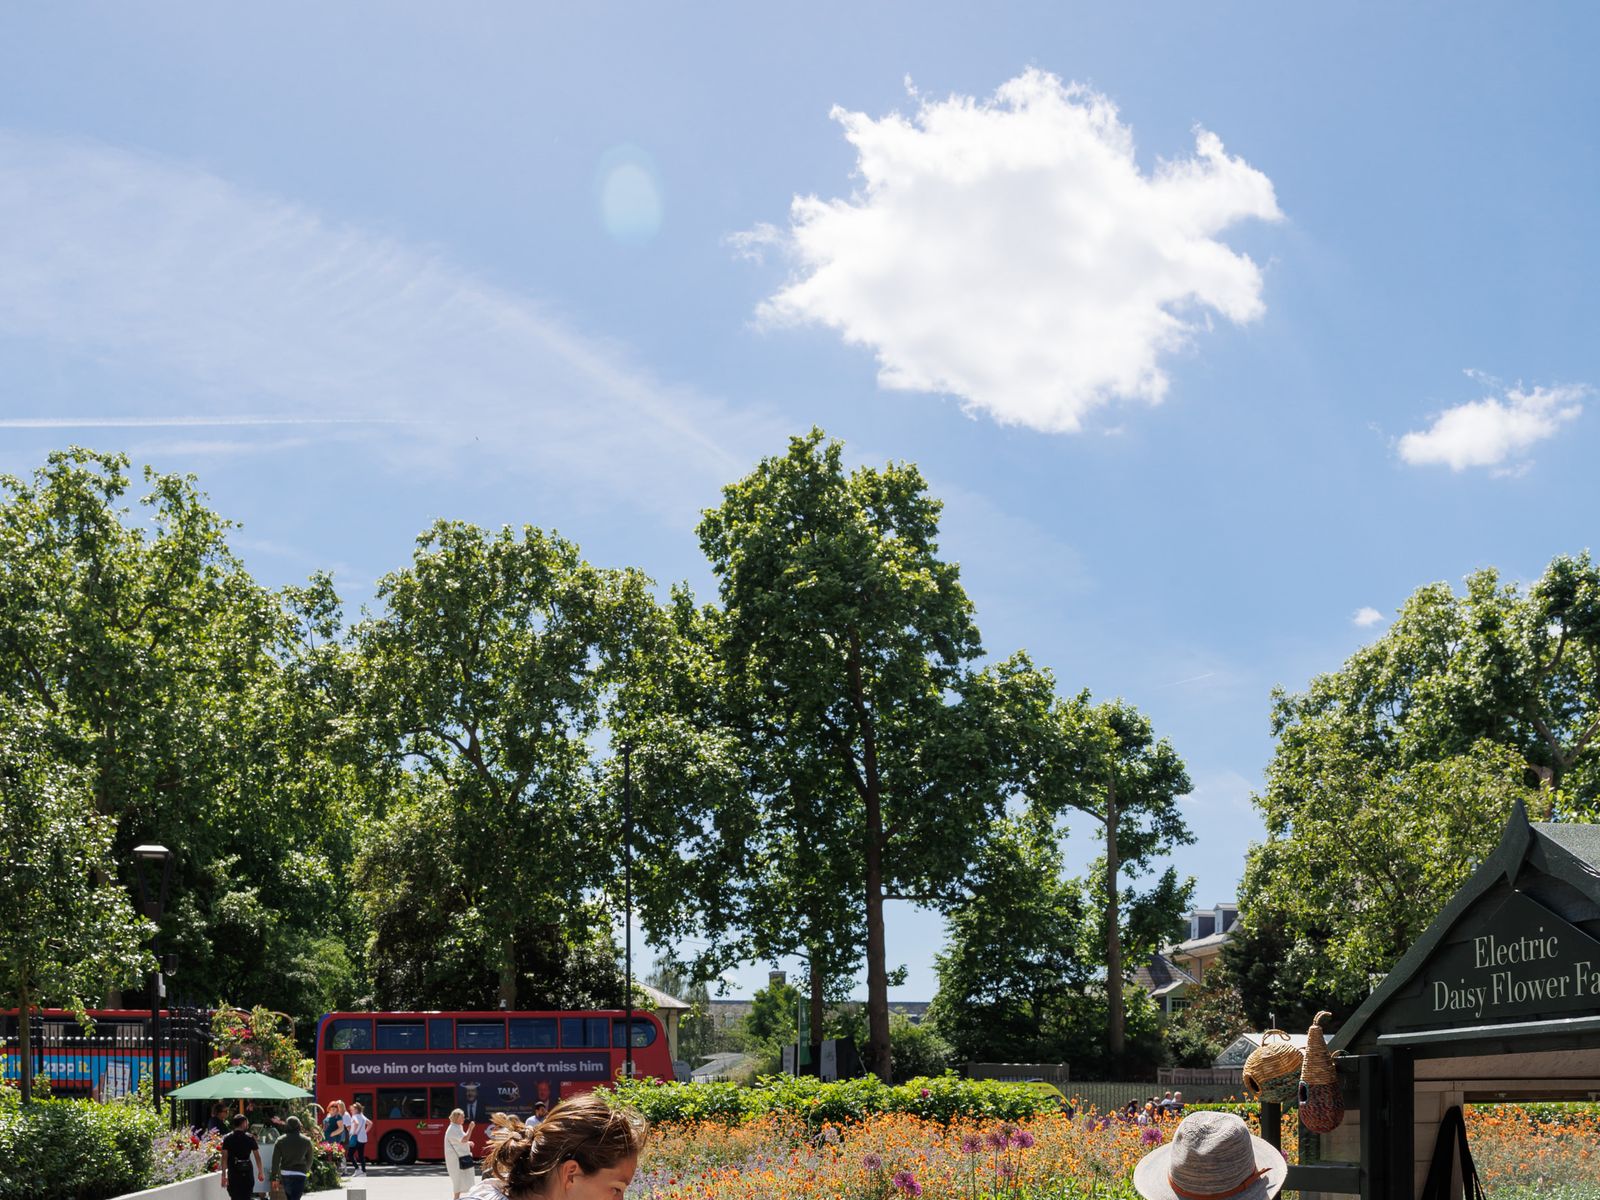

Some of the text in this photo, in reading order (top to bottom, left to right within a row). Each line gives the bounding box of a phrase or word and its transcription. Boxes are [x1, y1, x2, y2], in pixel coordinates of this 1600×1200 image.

[1473, 926, 1559, 969] Electric
[1432, 961, 1600, 1018] Daisy Flower Fa
[350, 1060, 604, 1074] Love him or hate him but don't miss him
[497, 1087, 519, 1096] TALK
